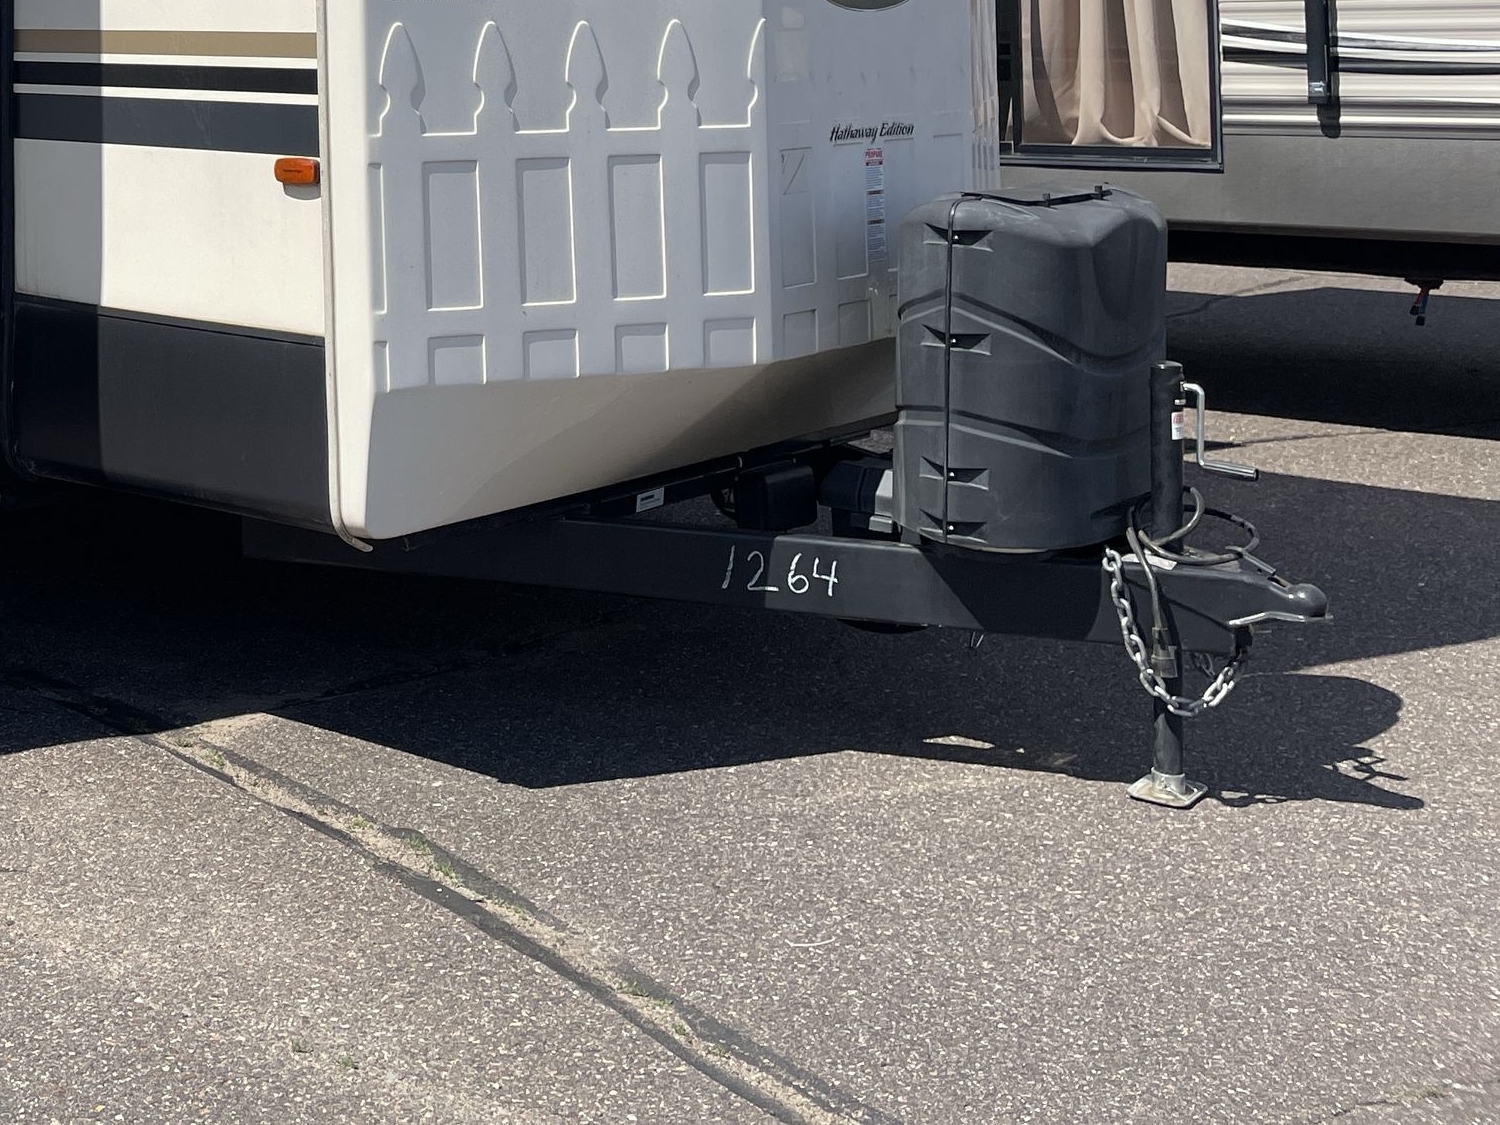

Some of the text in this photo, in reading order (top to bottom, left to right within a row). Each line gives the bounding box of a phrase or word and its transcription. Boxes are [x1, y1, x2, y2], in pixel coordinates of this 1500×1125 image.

[829, 121, 915, 144] Hathaway Edition
[720, 544, 839, 597] 1264
